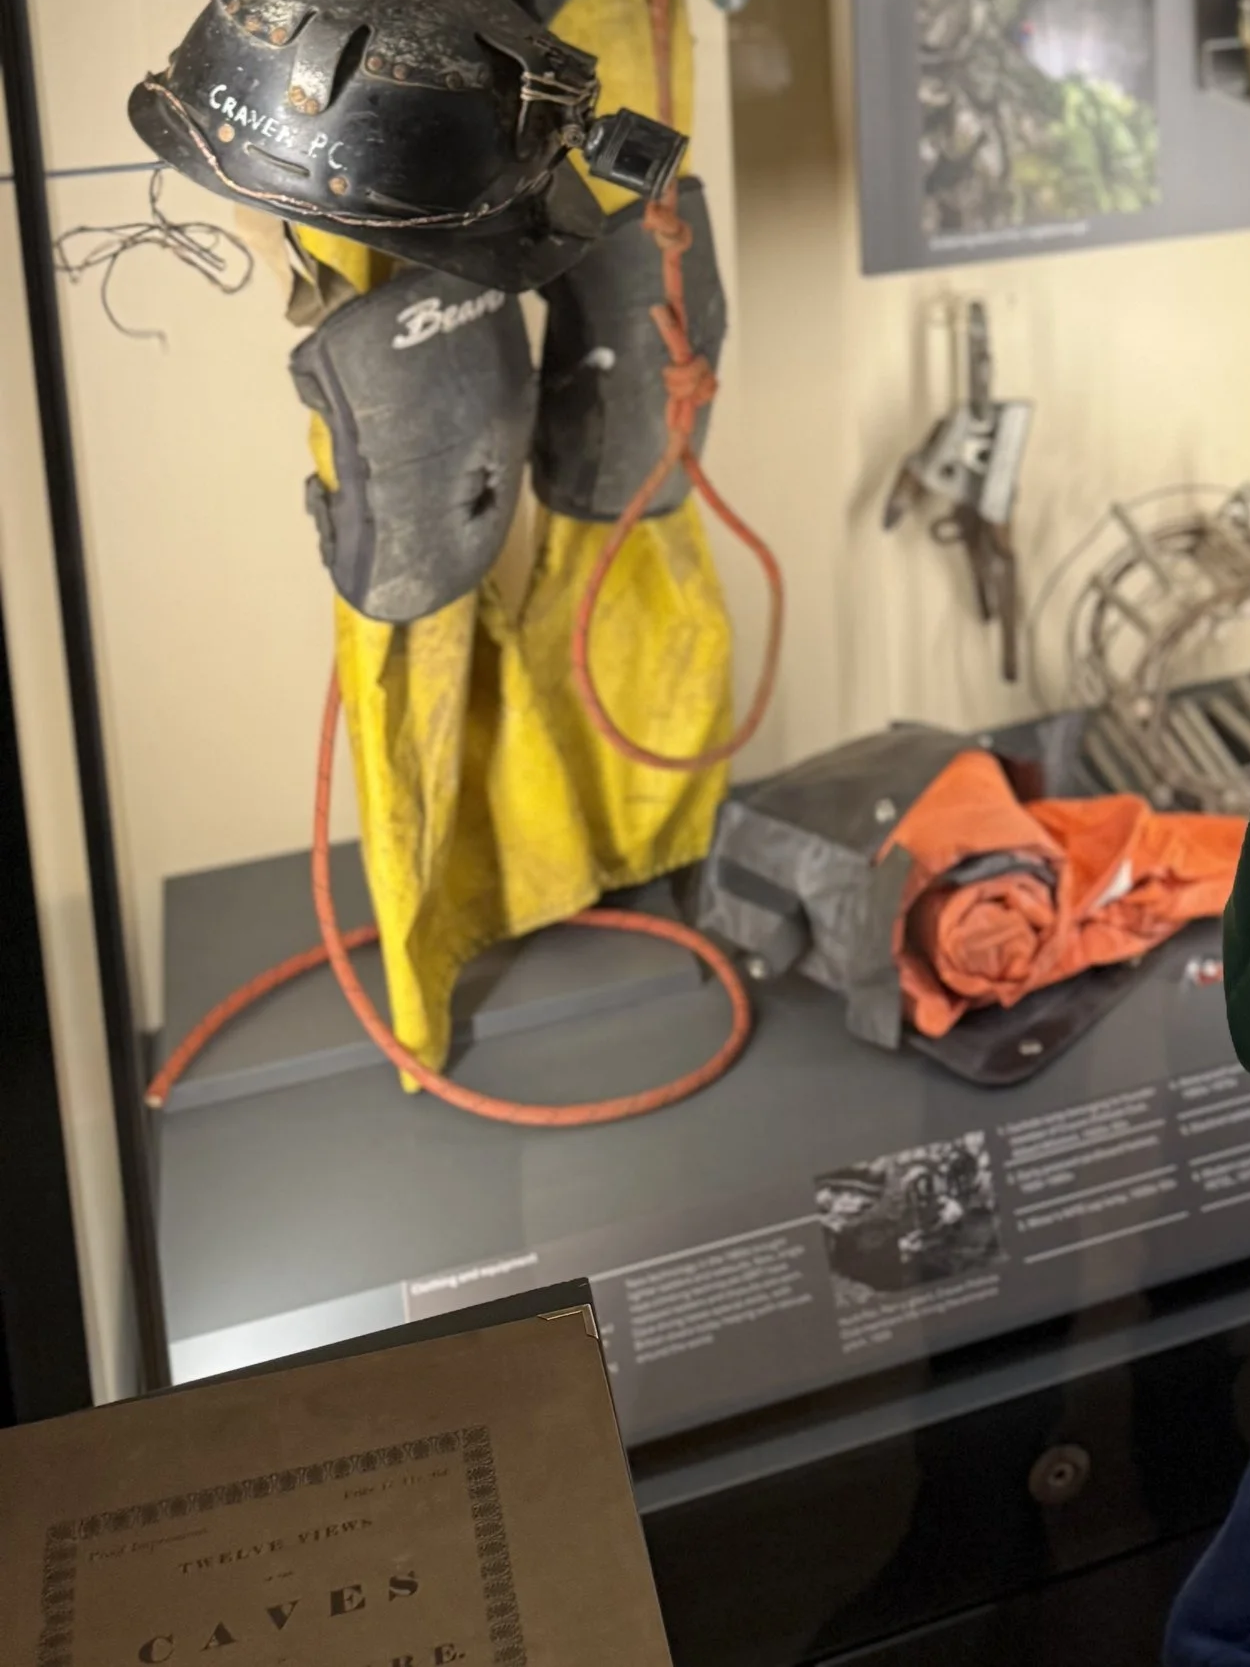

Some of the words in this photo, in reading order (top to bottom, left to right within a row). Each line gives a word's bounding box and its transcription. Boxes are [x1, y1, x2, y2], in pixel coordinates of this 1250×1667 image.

[208, 84, 297, 148] CRAVEN
[178, 1538, 284, 1575] TWELVE
[298, 1517, 373, 1545] VIEWS
[138, 1570, 419, 1664] CAVES
